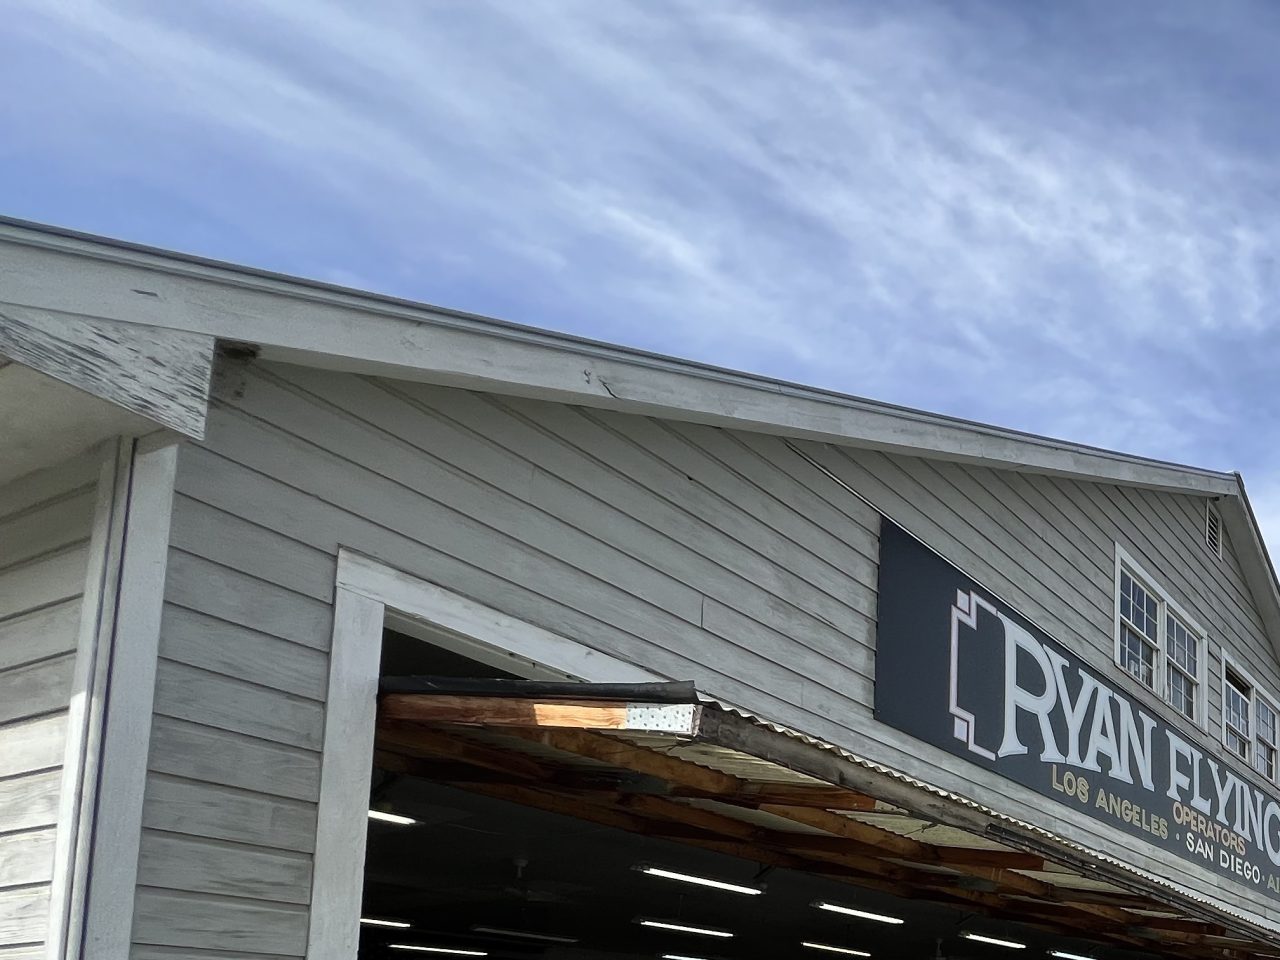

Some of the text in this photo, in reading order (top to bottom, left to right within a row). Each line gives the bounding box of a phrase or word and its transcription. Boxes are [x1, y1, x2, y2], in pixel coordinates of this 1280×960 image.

[997, 610, 1157, 792] RYAN
[1052, 764, 1089, 803] LOS
[1095, 788, 1168, 840] ANGELES
[1186, 833, 1214, 862] SAN
[1219, 852, 1261, 884] DIEGO
[1173, 801, 1246, 856] OPERATORS
